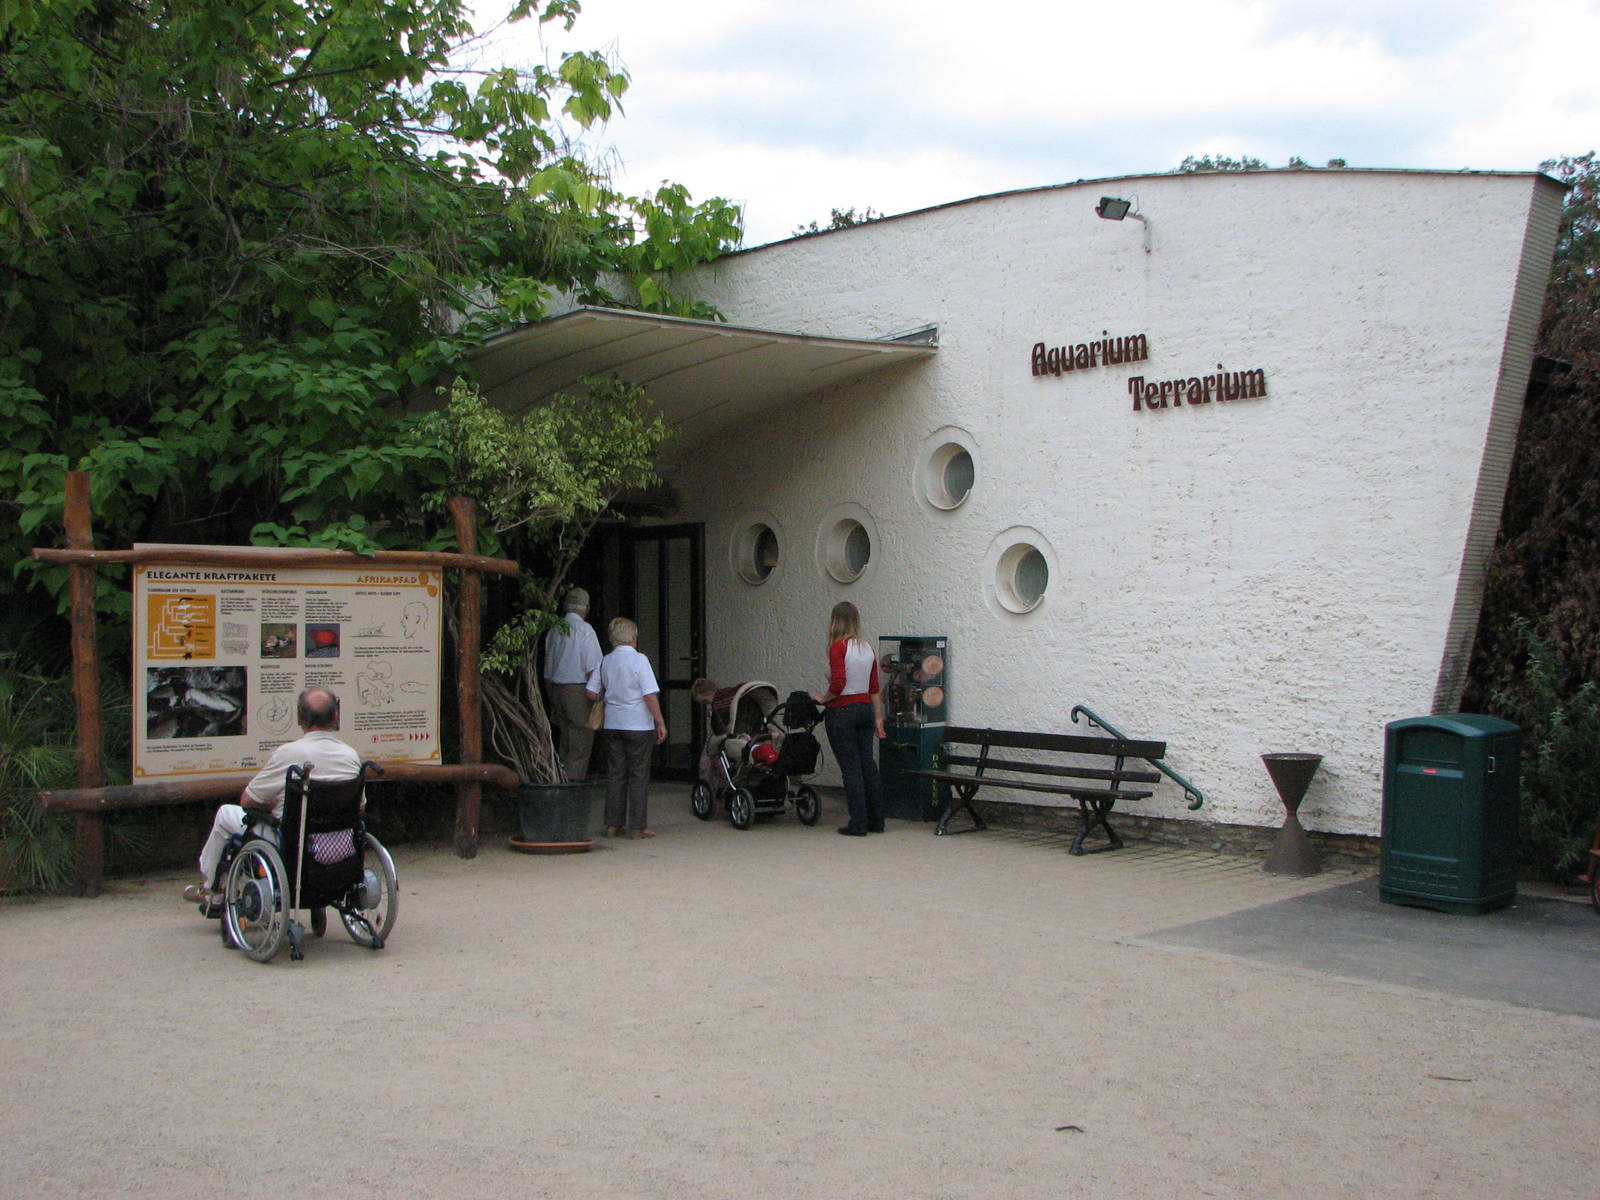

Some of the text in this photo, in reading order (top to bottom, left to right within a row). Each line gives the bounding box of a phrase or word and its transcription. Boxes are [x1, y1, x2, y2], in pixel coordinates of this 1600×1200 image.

[1031, 330, 1148, 376] Aquarium
[1128, 363, 1267, 411] Terrarium
[147, 571, 277, 581] ELEGANTE KRAFTPAKETE
[357, 575, 417, 584] AFRIKAPFAD
